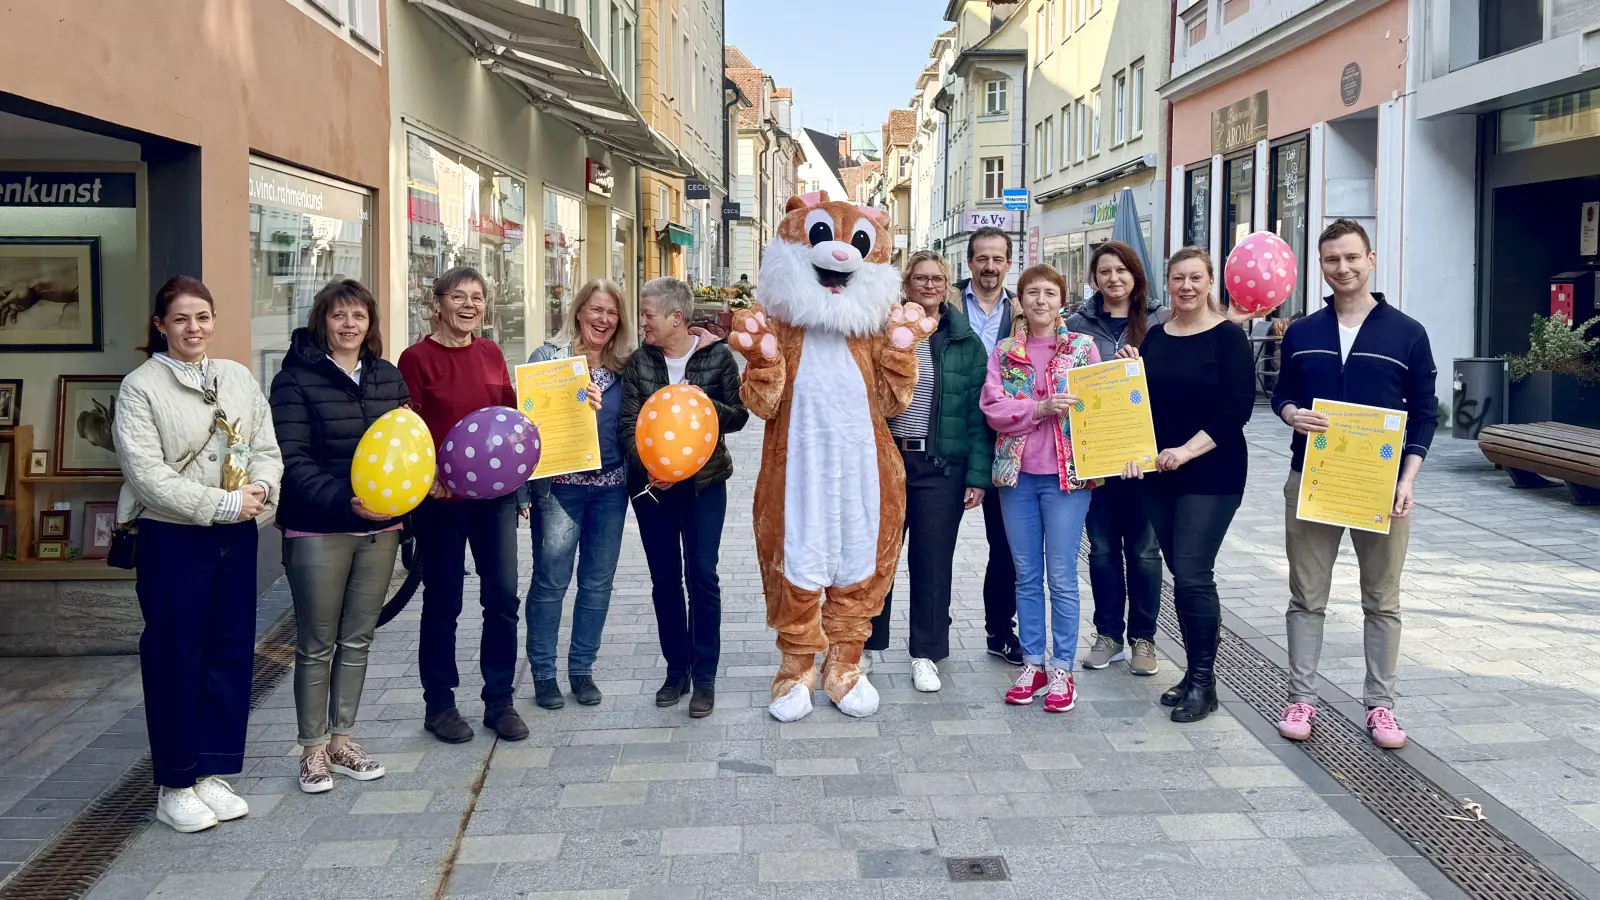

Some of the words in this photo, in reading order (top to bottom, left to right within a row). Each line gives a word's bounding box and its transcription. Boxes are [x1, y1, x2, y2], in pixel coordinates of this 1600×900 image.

[1226, 121, 1254, 148] AROMA
[0, 176, 102, 203] nkunst
[971, 214, 980, 225] T
[980, 216, 988, 225] &
[990, 214, 1005, 227] Vy
